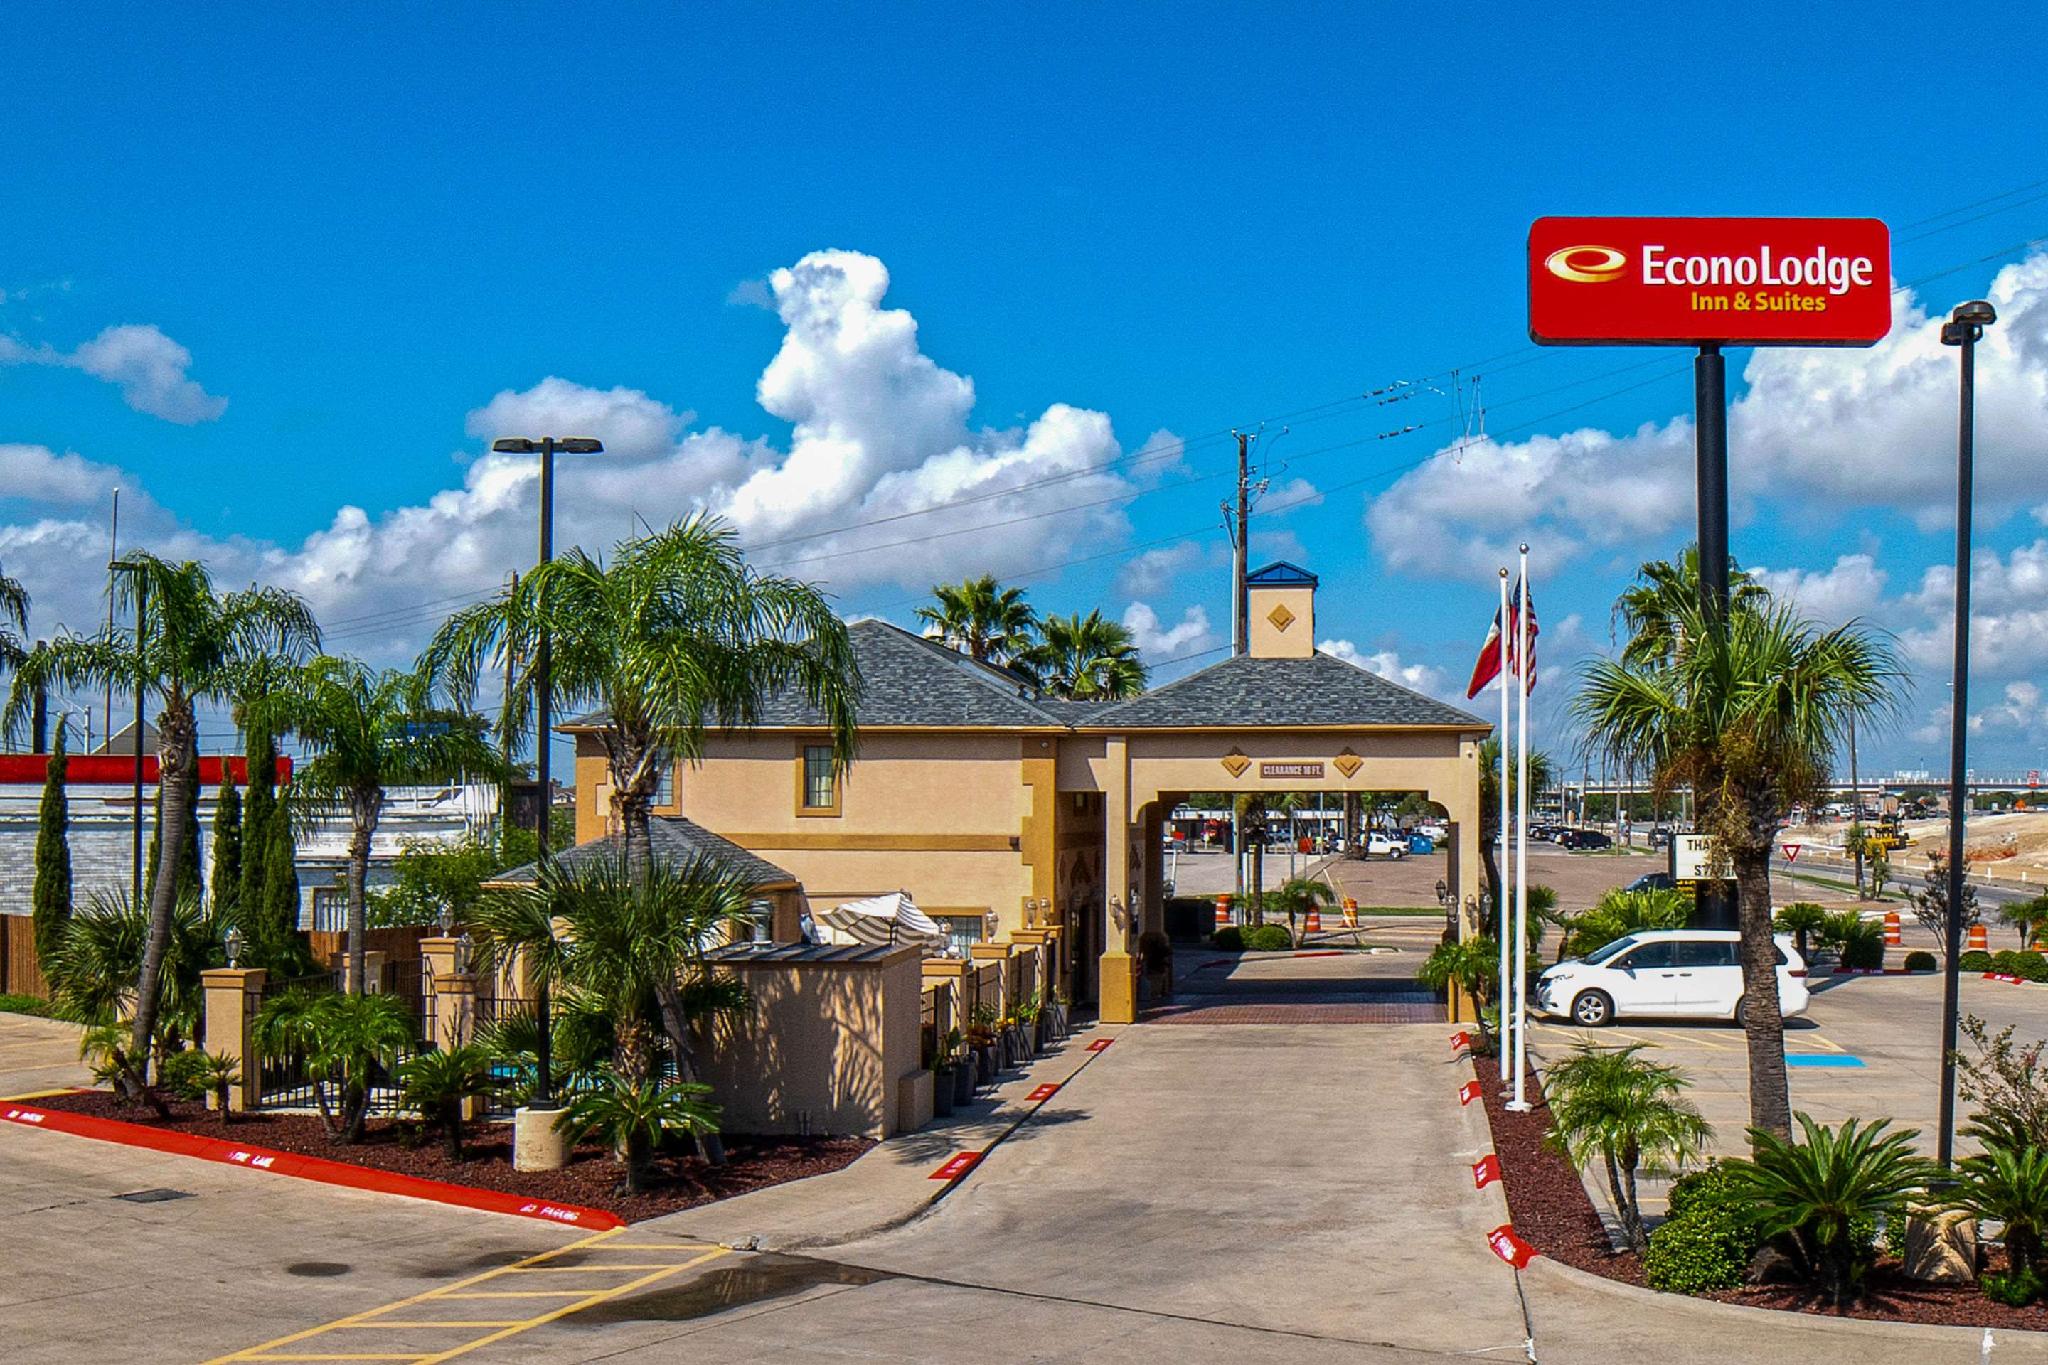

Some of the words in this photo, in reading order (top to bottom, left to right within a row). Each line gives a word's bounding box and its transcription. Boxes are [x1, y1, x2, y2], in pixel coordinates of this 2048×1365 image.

[1642, 245, 1873, 295] EconoLodge
[1691, 291, 1729, 311] Inn
[1734, 291, 1751, 311] &
[1755, 291, 1826, 312] Suites
[1263, 765, 1302, 775] CLEARANCE
